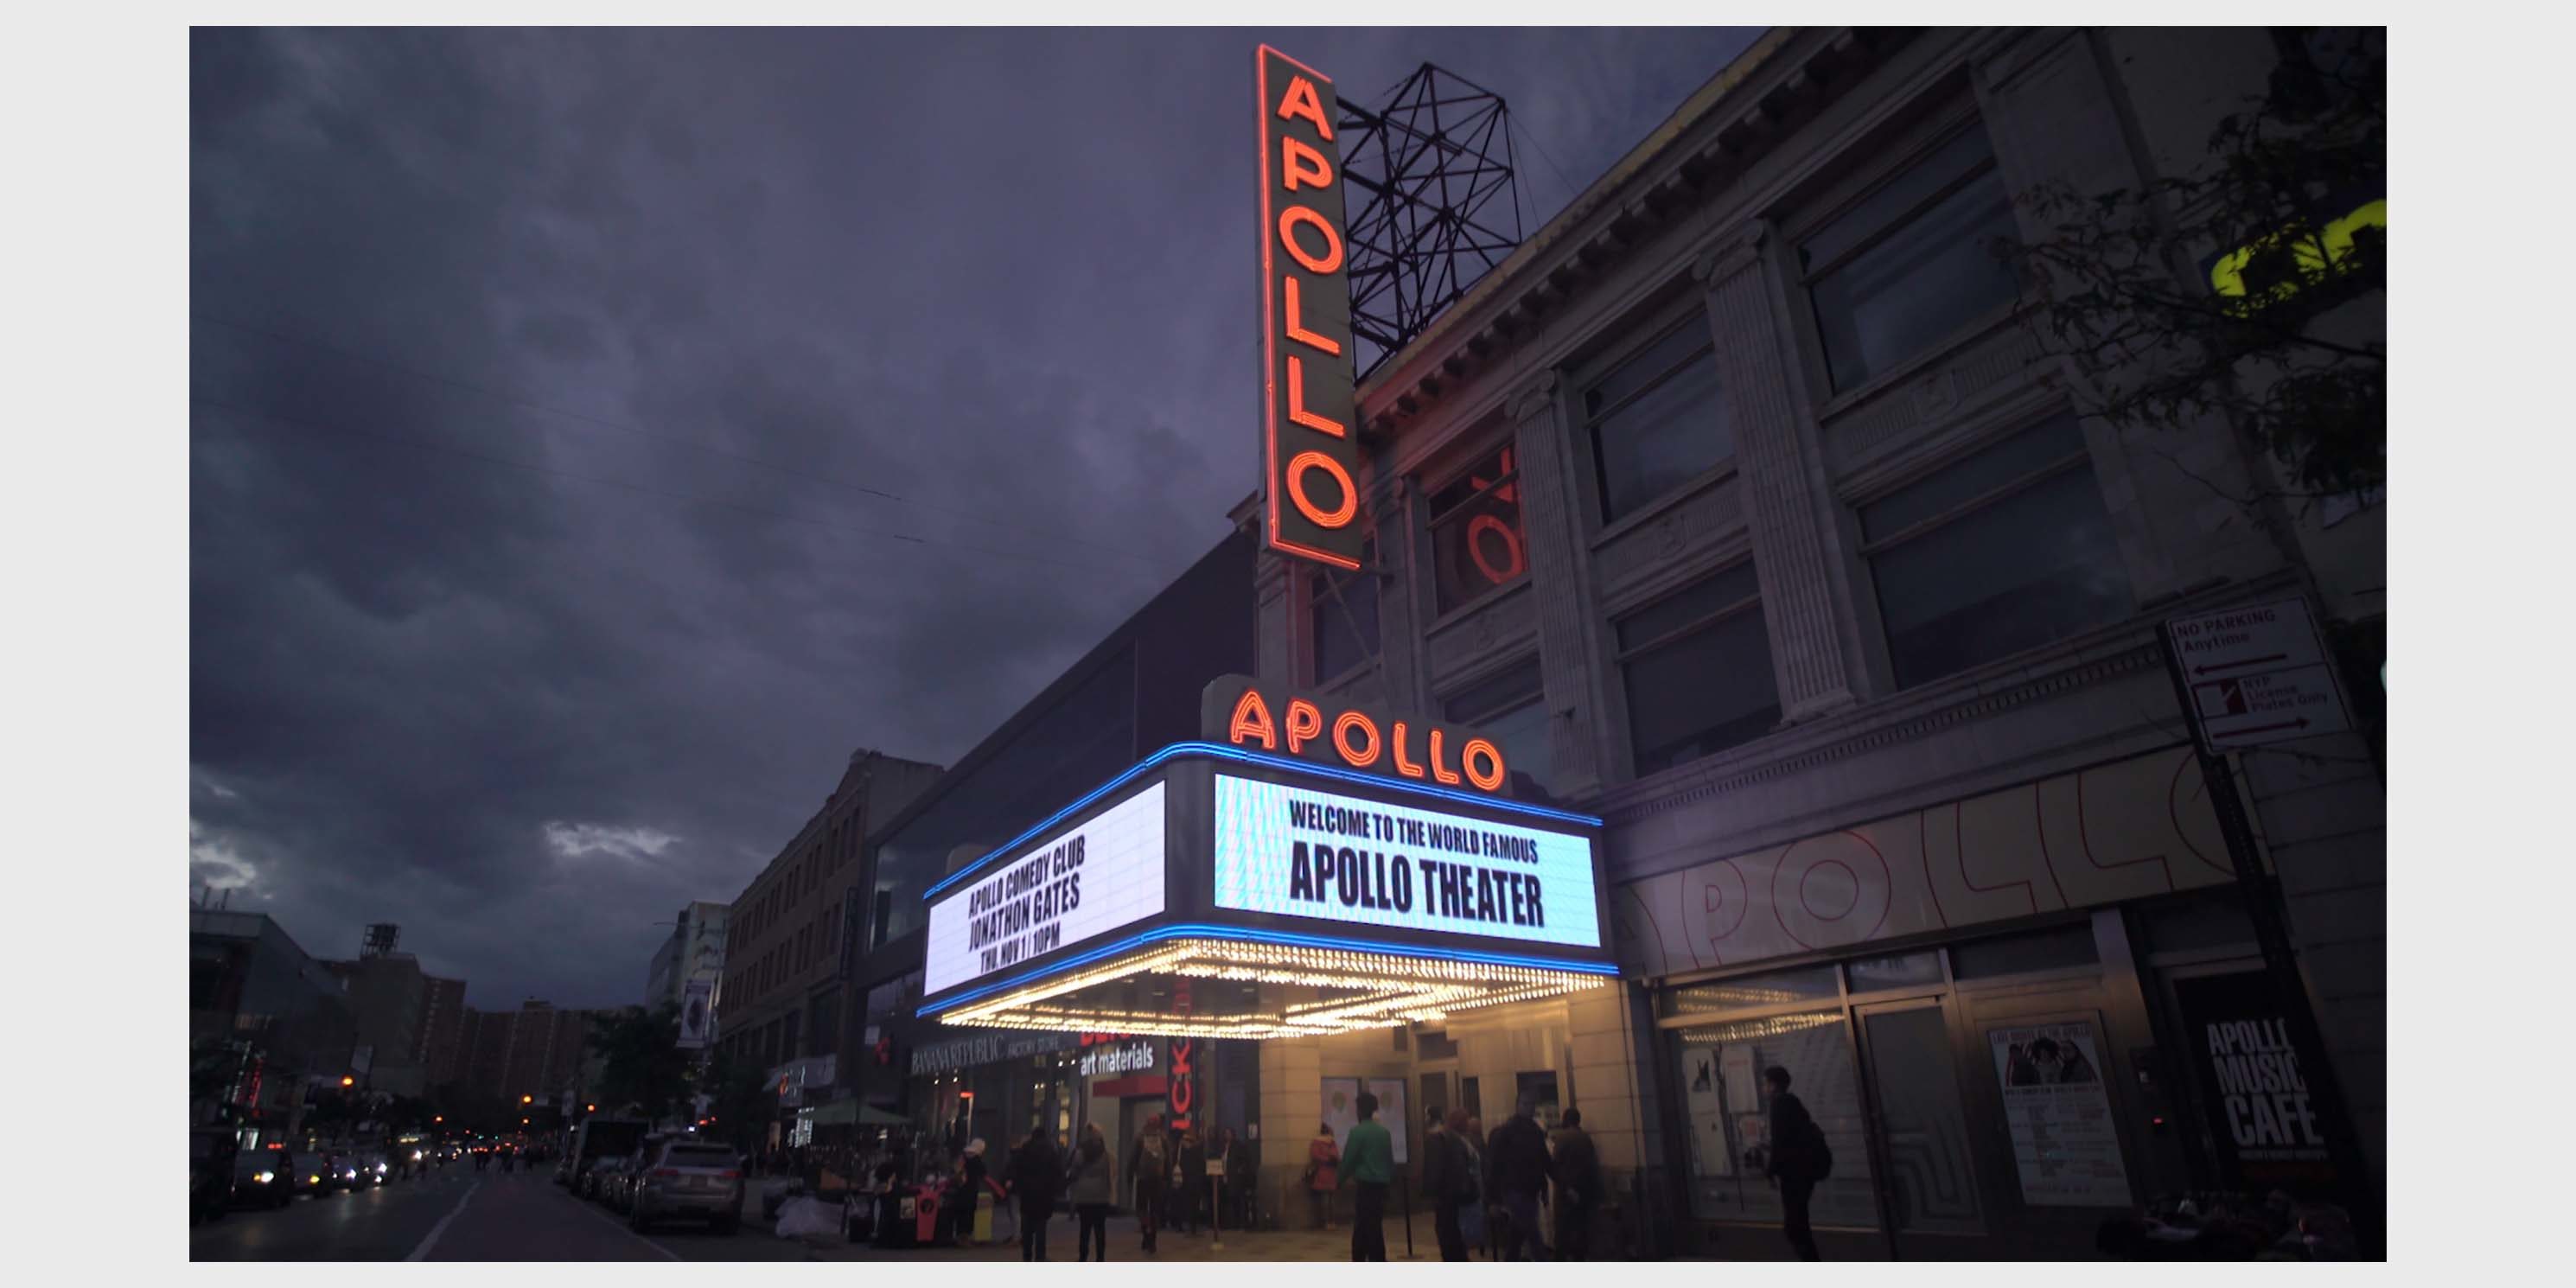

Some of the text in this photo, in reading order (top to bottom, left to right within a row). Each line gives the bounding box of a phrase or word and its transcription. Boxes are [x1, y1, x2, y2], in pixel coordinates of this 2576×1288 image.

[1277, 75, 1358, 528] APOLLO
[2177, 609, 2276, 637] NO PARKING
[2184, 632, 2249, 652] Anytime
[1229, 687, 1505, 792] APOLLO
[1289, 799, 1540, 865] WELCOME TO THE WORLD FAMOUS
[968, 834, 1086, 920] APOLLO COMEDY CLUB
[1289, 840, 1546, 928] APOLLO THEATER
[968, 870, 1080, 953] JONATHON GATES
[1000, 936, 1020, 966] NOV
[1033, 921, 1061, 955] 10PM
[1081, 1041, 1154, 1077] art materials
[2213, 1052, 2308, 1095] MUSIC
